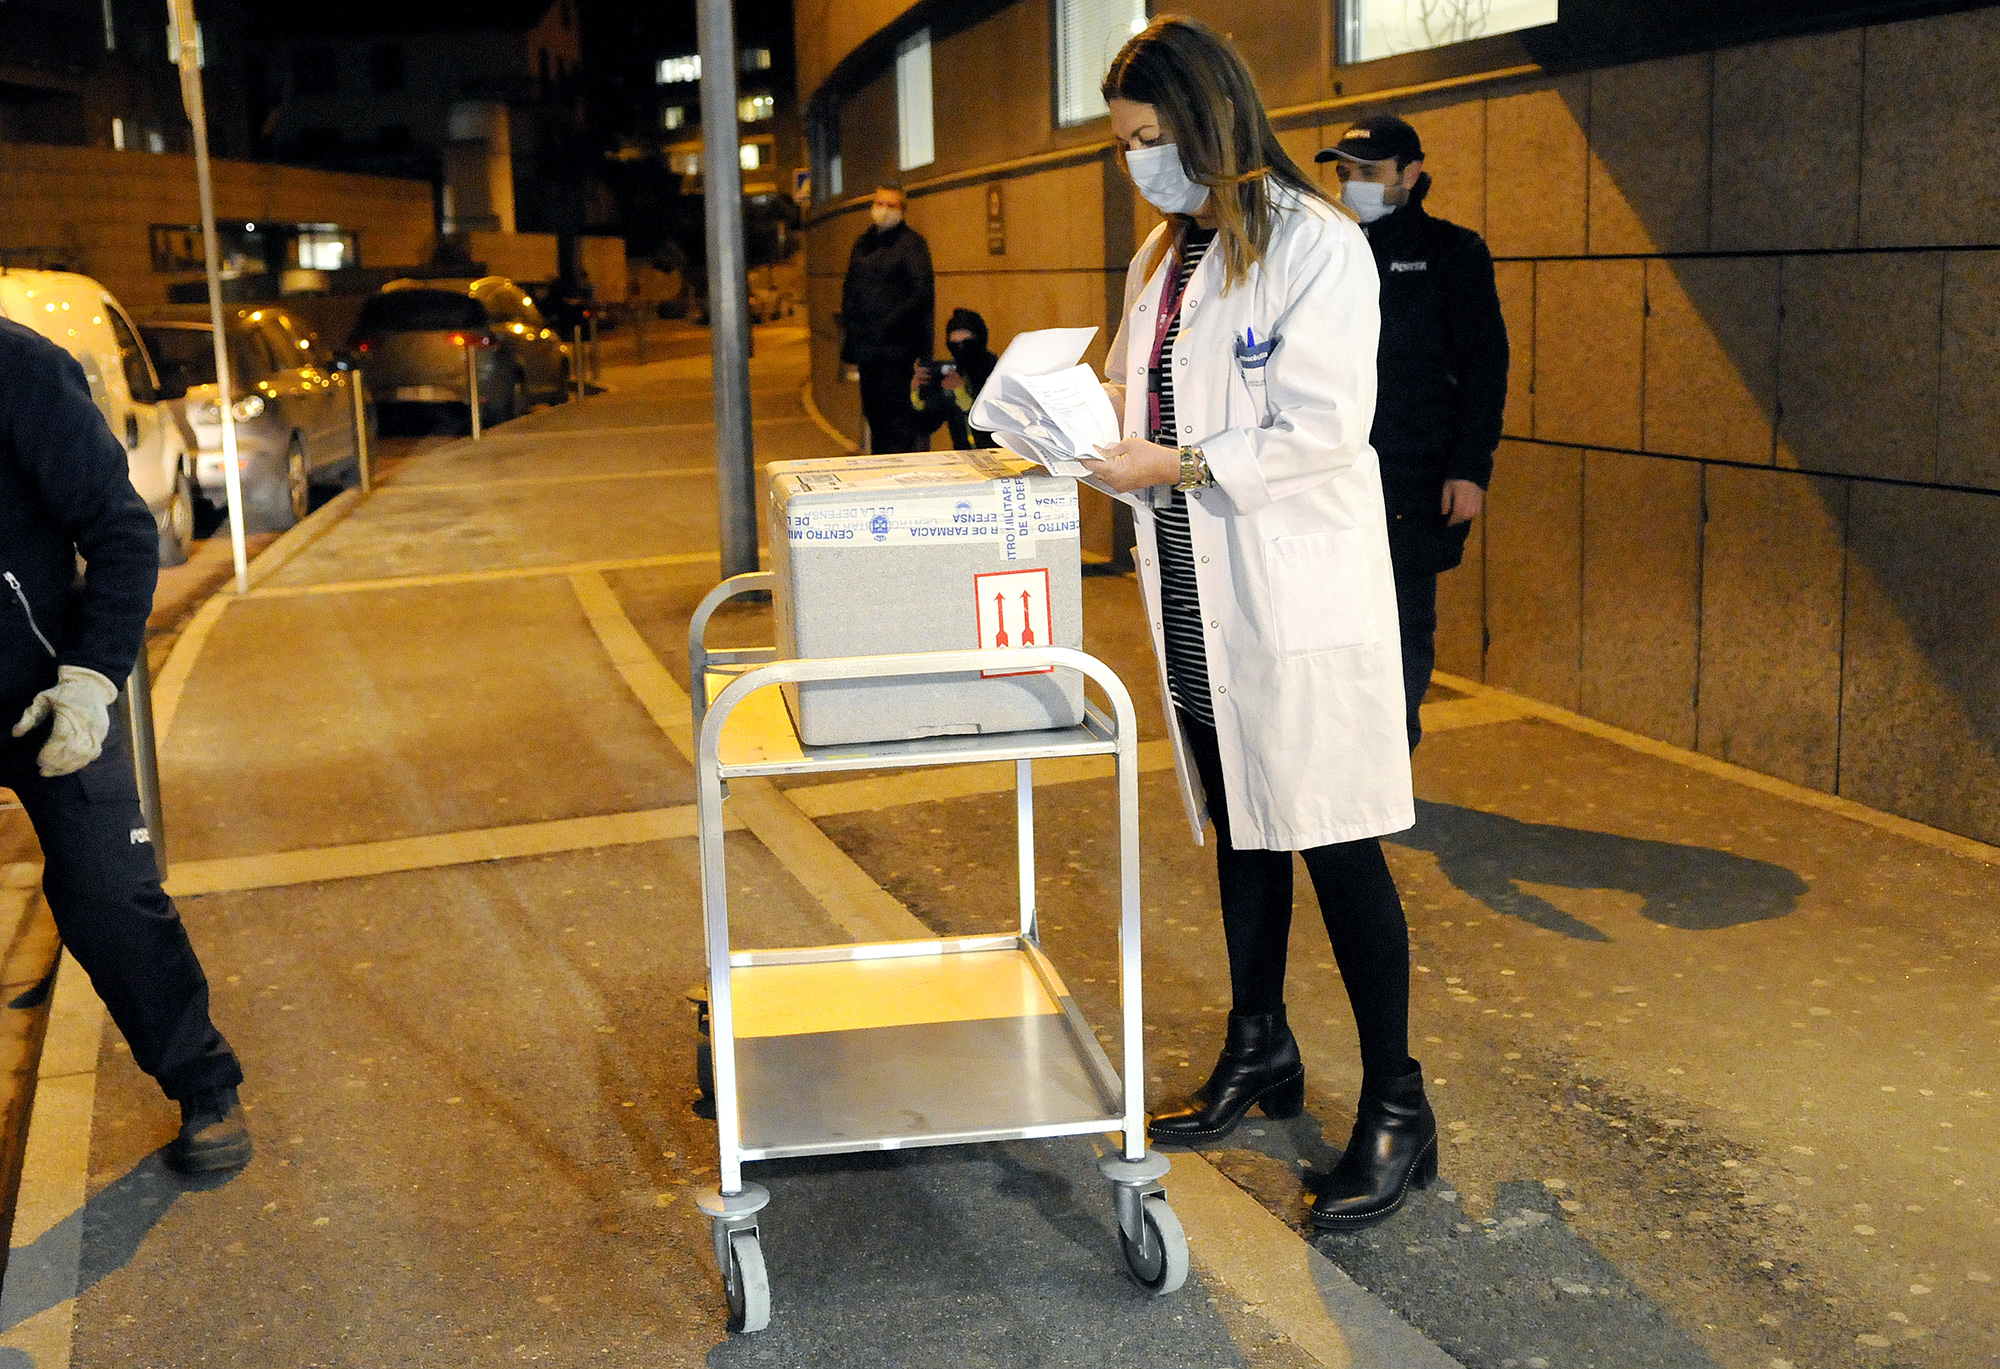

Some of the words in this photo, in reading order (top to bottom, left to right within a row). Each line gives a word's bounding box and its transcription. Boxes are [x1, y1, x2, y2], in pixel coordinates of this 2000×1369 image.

[1014, 477, 1026, 501] DEF
[1035, 497, 1078, 507] EFENSA
[1018, 503, 1028, 518] LA
[795, 516, 810, 526] DE
[952, 513, 997, 523] EFENSA
[909, 526, 968, 537] FARMACIA
[971, 526, 987, 535] DE
[1018, 521, 1029, 536] DE
[806, 529, 854, 540] CENTRO
[1006, 534, 1017, 560] TRO
